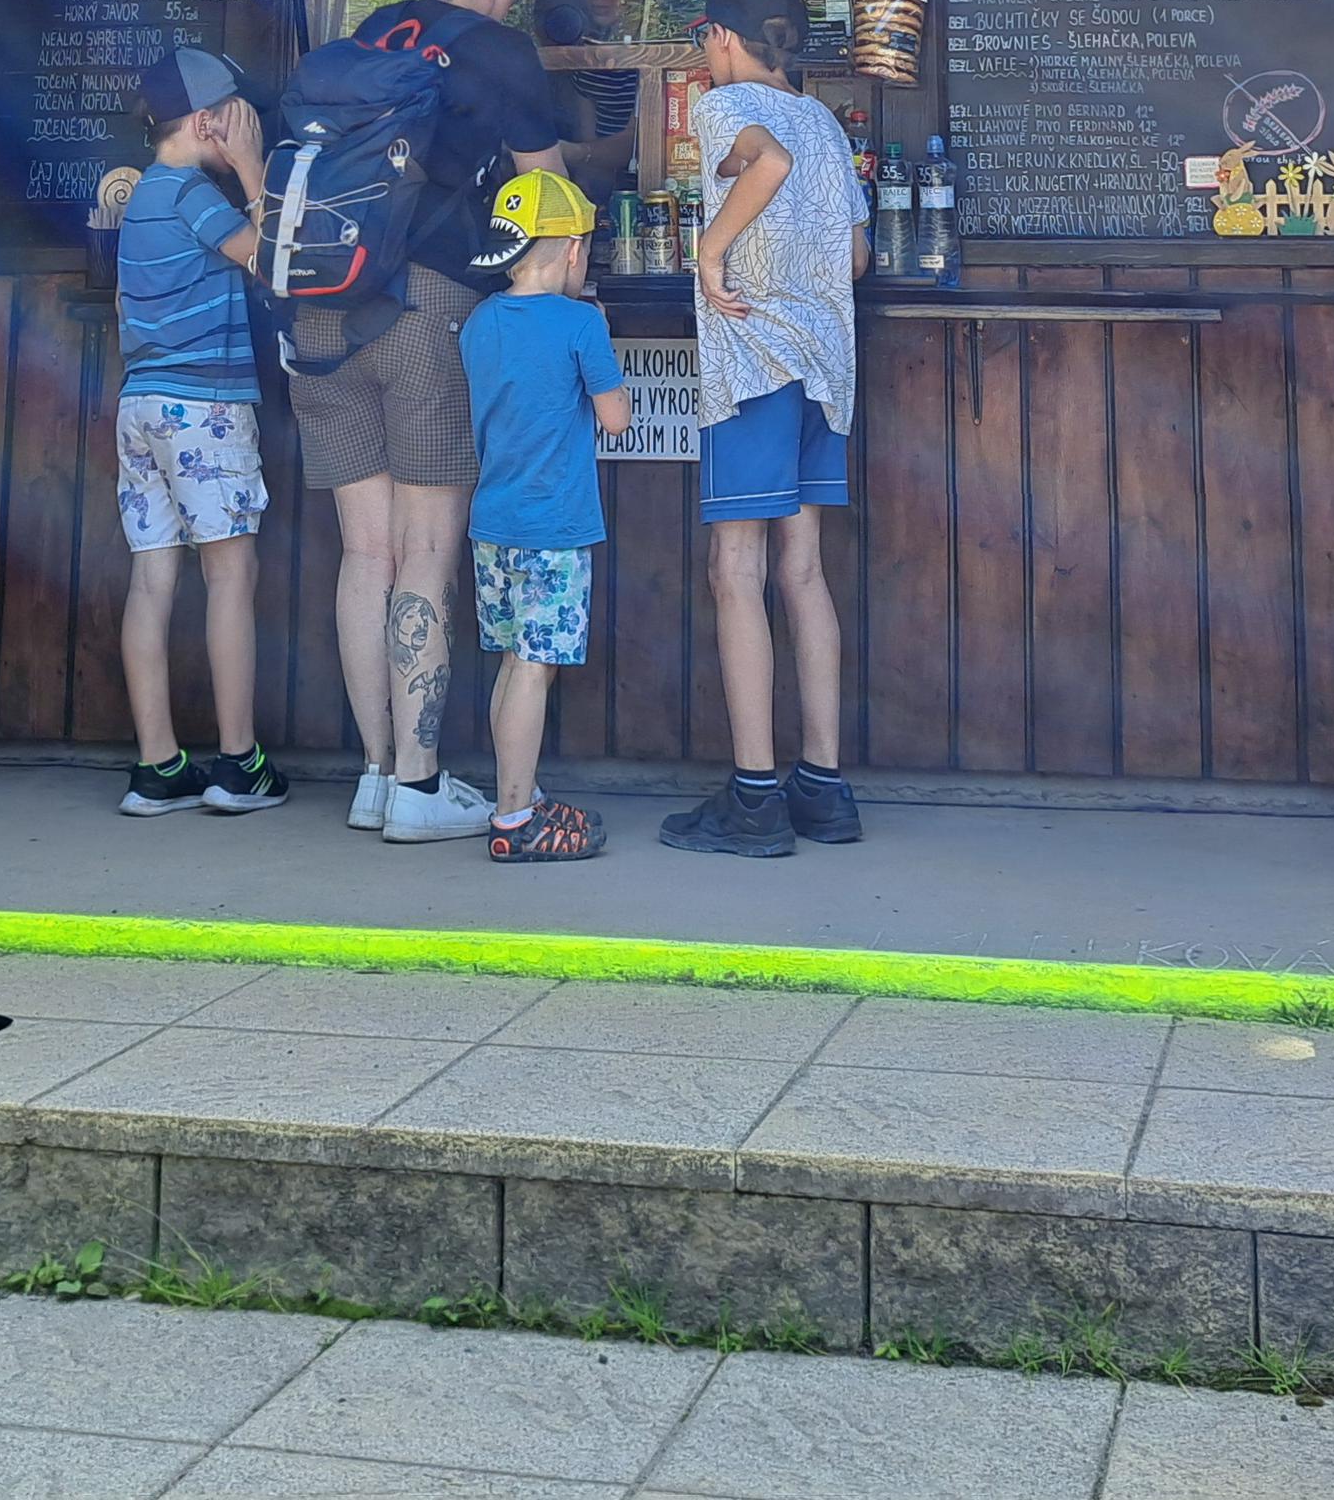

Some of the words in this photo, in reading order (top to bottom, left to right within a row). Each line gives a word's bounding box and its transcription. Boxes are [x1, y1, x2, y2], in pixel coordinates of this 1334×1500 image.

[64, 1, 98, 22] HORKÝ
[101, 2, 140, 22] JAVOR
[973, 6, 1060, 32] BUCHTIČKY
[1068, 9, 1087, 27] SE
[1091, 2, 1142, 25] ŠODOU
[971, 34, 1053, 53] BROWNIES
[35, 73, 79, 92] TOČENÁ
[81, 74, 143, 92] MALINOVKA
[33, 92, 76, 112] TOČENÁ
[80, 93, 124, 113] KOFOLA
[1034, 103, 1063, 118] PIVO
[1067, 102, 1127, 118] BERNARD
[32, 117, 78, 138] TOČENÉ
[79, 118, 108, 138] PIVO
[672, 424, 695, 455] 18.
